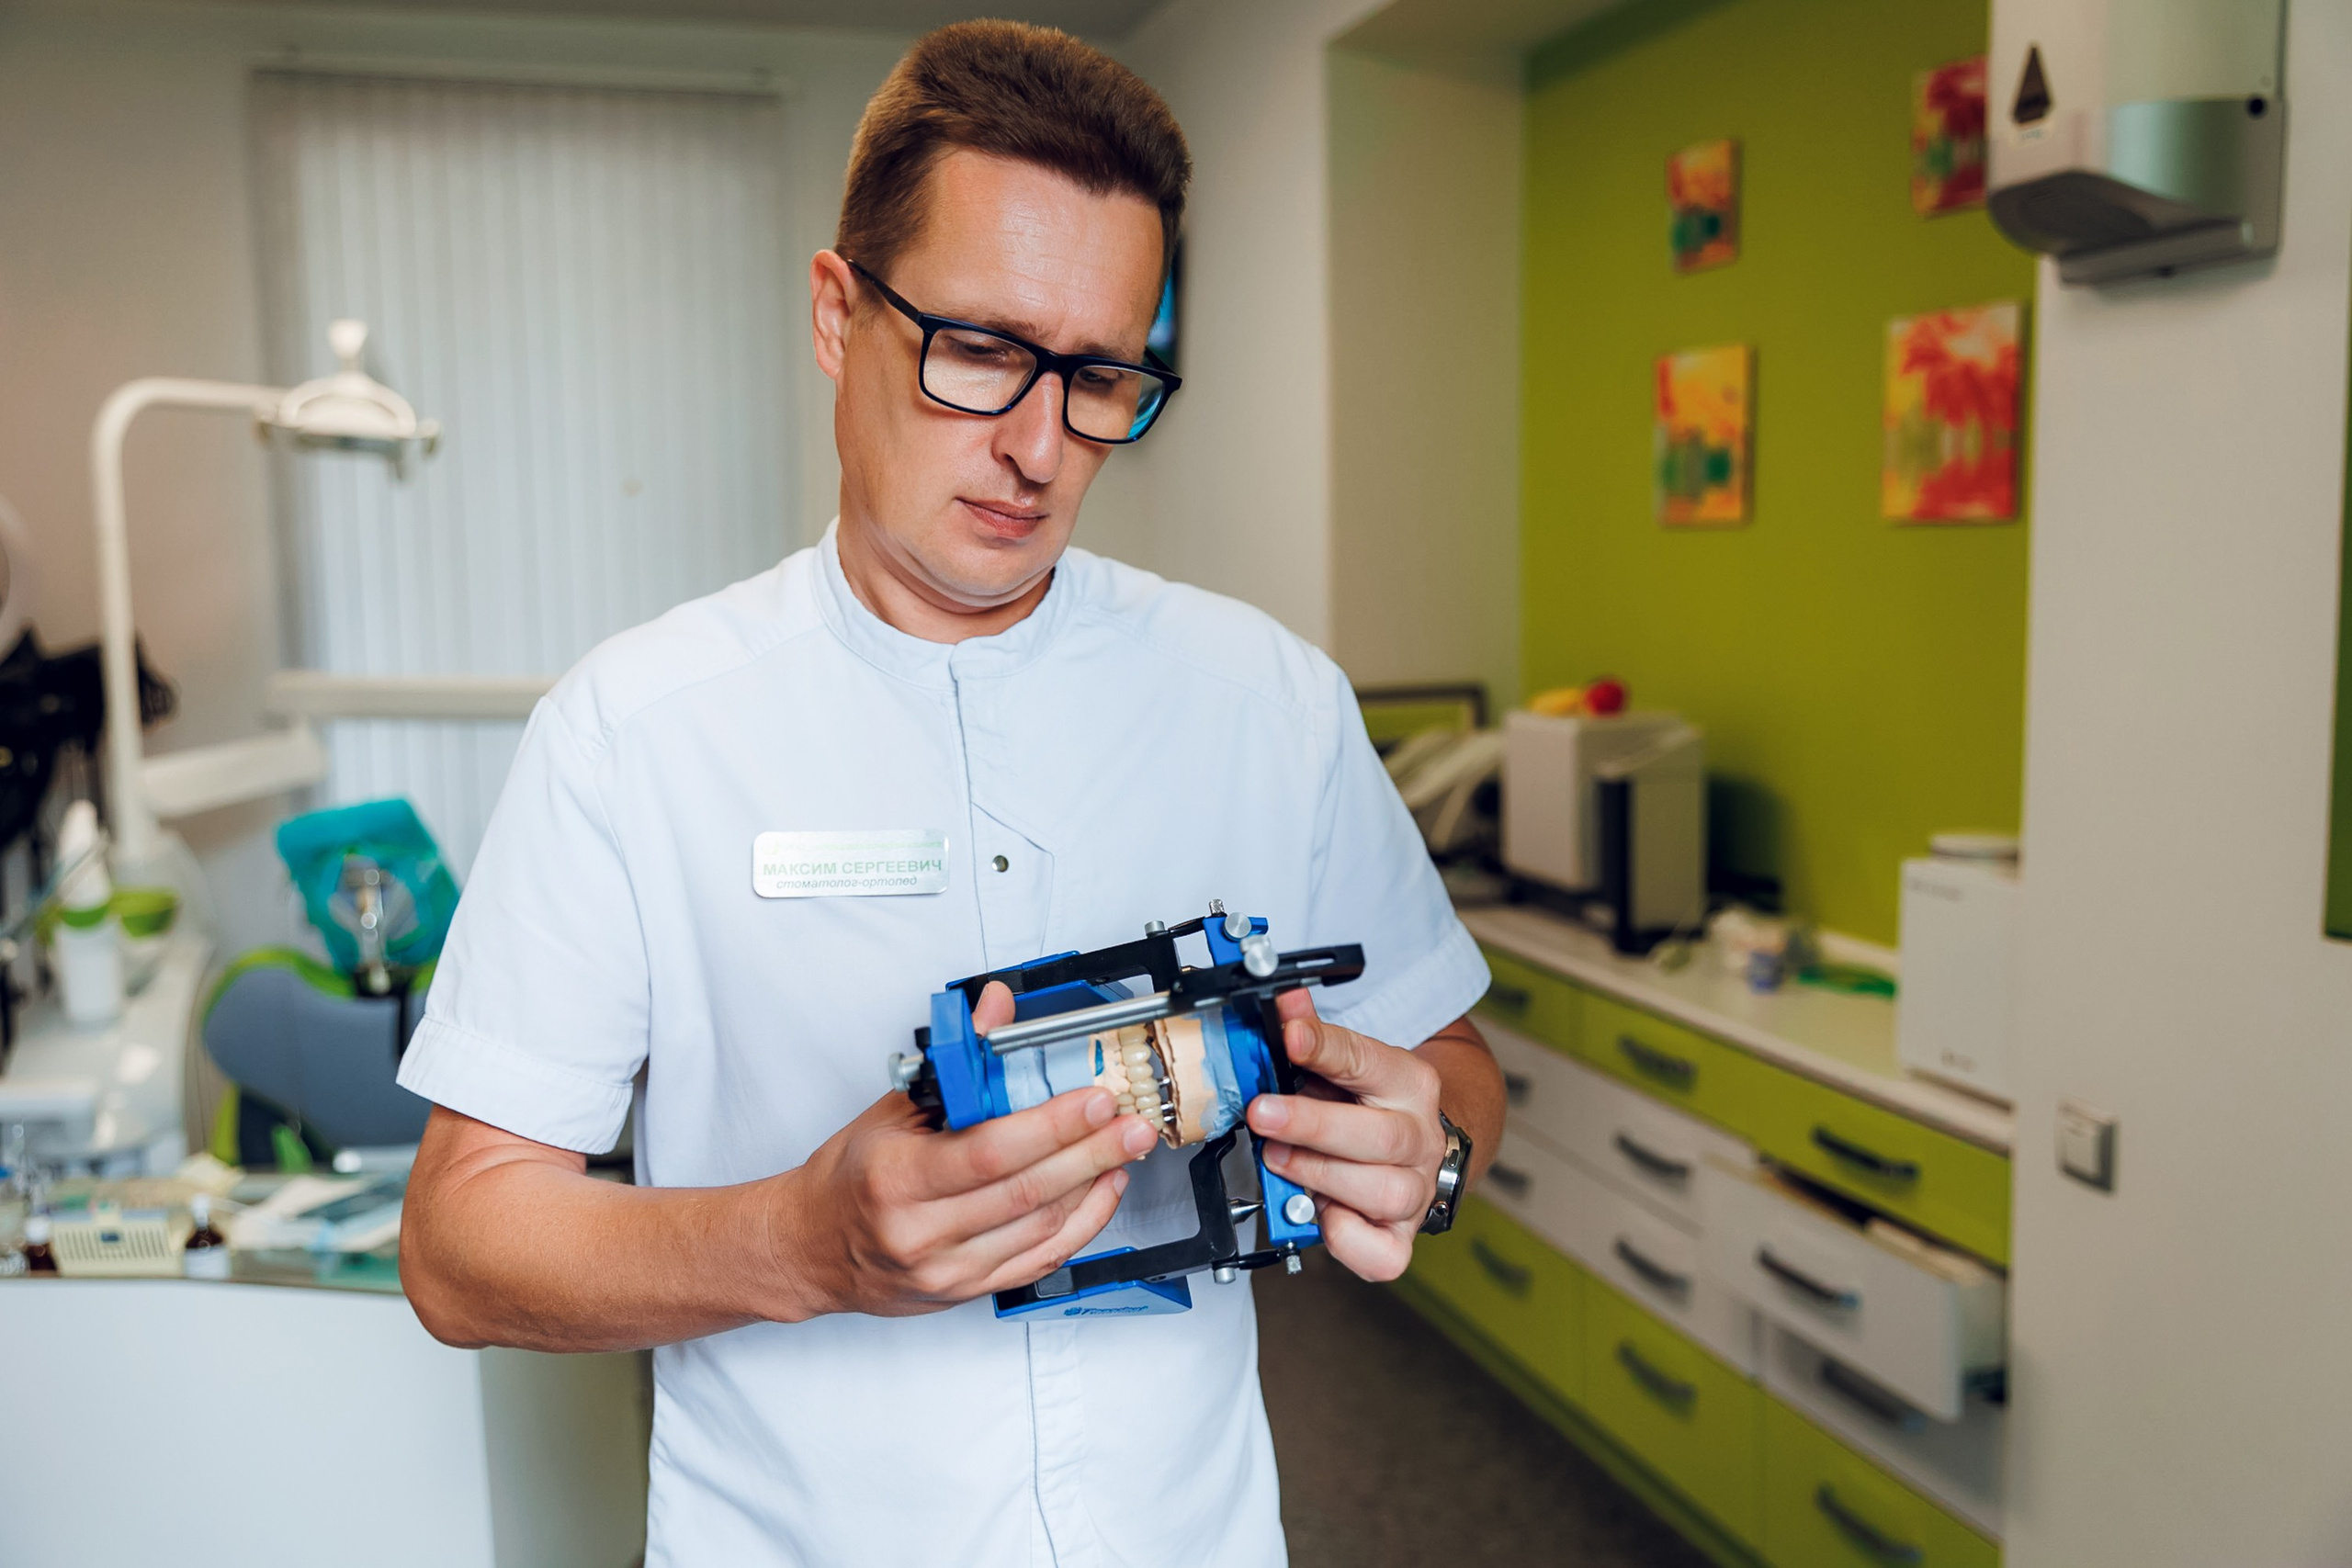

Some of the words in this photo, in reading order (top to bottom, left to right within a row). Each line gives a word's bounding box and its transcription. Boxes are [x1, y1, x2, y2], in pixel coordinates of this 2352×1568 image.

[763, 862, 837, 876] МАКСИМ
[842, 860, 943, 874] СЕРГЕЕВИЧ
[776, 875, 918, 890] стоматолог-ортопед
